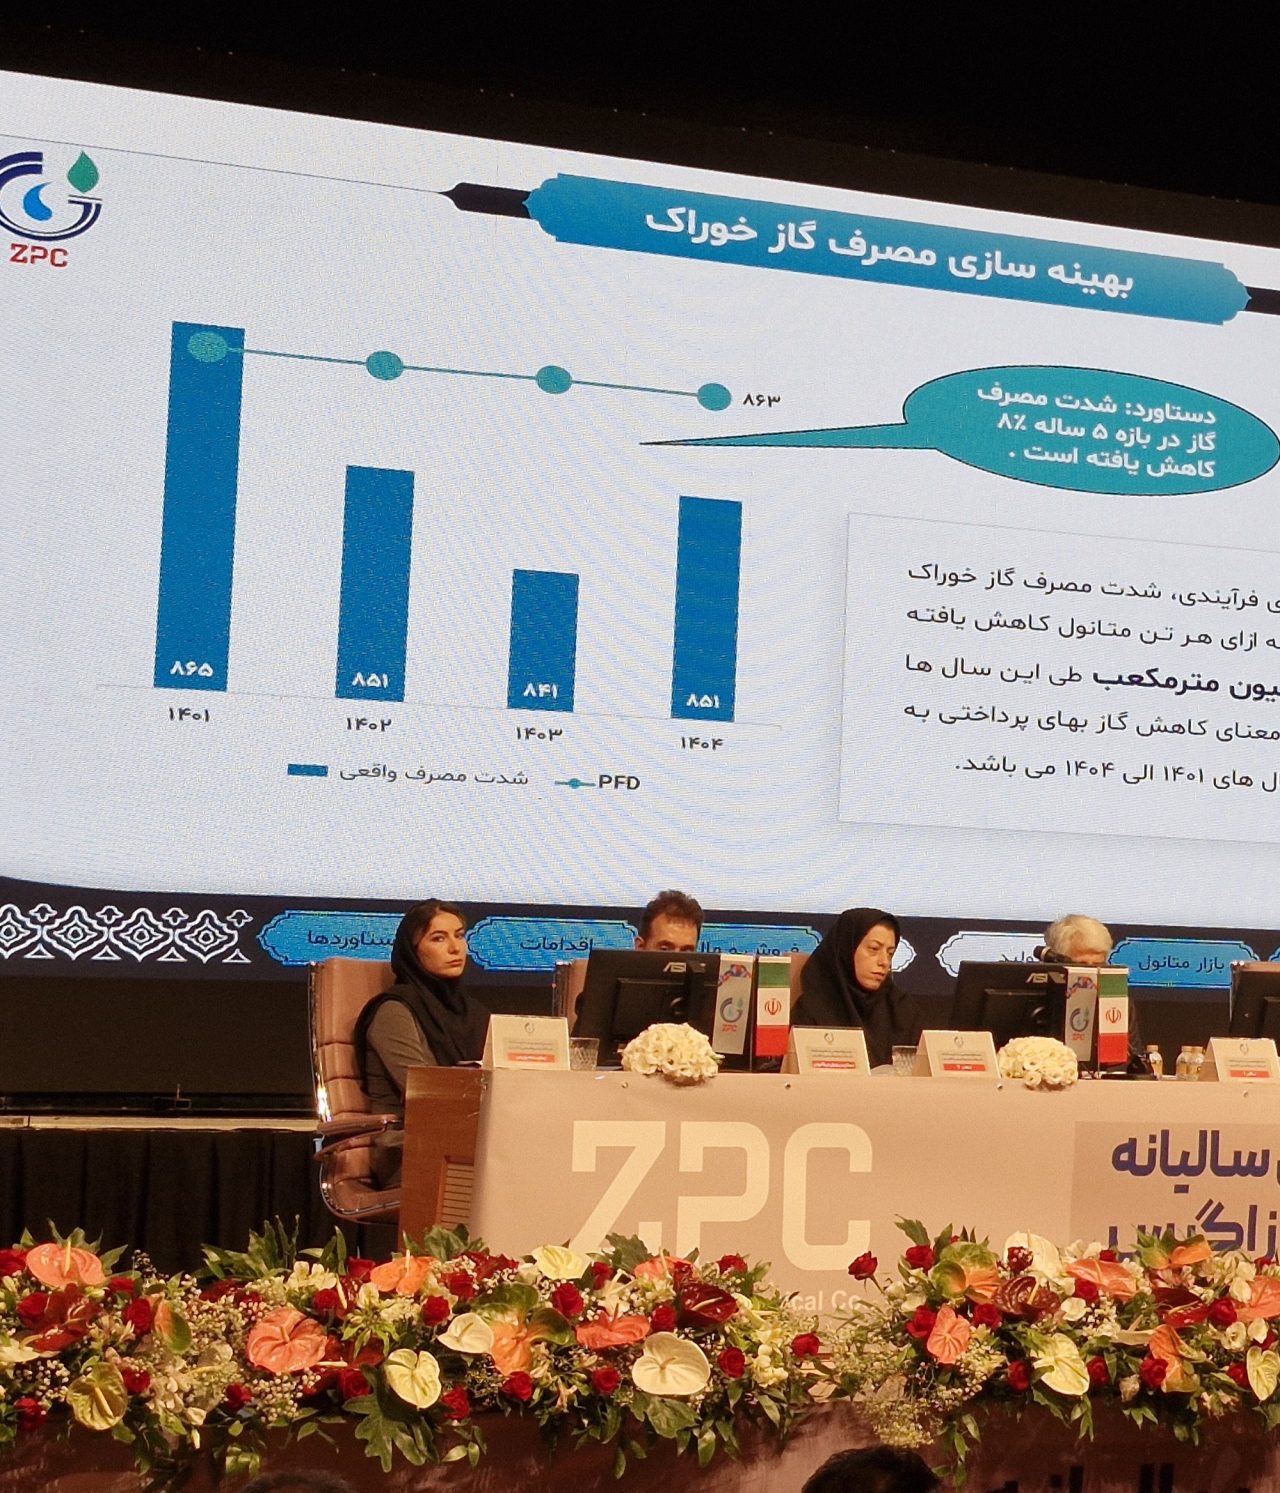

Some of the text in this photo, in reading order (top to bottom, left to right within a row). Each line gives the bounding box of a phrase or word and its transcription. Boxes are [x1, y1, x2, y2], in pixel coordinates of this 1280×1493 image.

[10, 243, 69, 268] ZPC
[645, 206, 1134, 299] بهینه سازی مصرف گاز خوراک
[742, 393, 782, 408] ۸۶۳
[977, 381, 1048, 407] مصرف
[1054, 394, 1118, 414] شدت
[1034, 417, 1086, 437] ساله
[1091, 423, 1109, 440] ۵
[1115, 426, 1152, 449] بازه
[1156, 433, 1181, 451] در
[1186, 431, 1217, 454] گاز
[1023, 446, 1079, 464] است
[1085, 450, 1140, 476] یافته
[1146, 455, 1216, 478] کاهش
[907, 563, 977, 588] خوراک
[984, 567, 1016, 591] گاز
[1022, 571, 1092, 596] مصرف
[1100, 582, 1162, 599] شدت
[906, 605, 967, 631] یافته
[974, 611, 1051, 633] کاهش
[1057, 617, 1132, 640] متانول
[1139, 626, 1174, 645] تن
[1179, 633, 1213, 648] هر
[1220, 630, 1258, 653] ازای
[169, 660, 214, 678] ۸۶۵
[905, 653, 933, 674] ها
[941, 657, 992, 679] سال
[999, 663, 1040, 685] این
[351, 671, 389, 688] ۸۵۱
[1048, 665, 1083, 687] طی
[1092, 667, 1220, 697] مترمکعب
[523, 682, 558, 699] ۸۴۱
[686, 692, 720, 709] ۸۵۱
[168, 706, 210, 723] ۱۴۰۱
[903, 704, 931, 723] به
[938, 705, 1030, 732] پرداختی
[1037, 710, 1089, 733] بهای
[1095, 711, 1129, 735] گاز
[346, 717, 392, 733] ۱۴۰۲
[516, 726, 564, 742] ۱۴۰۳
[1135, 716, 1208, 738] کاهش
[1215, 721, 1280, 743] معنای
[681, 736, 724, 751] ۱۴۰۴
[339, 763, 529, 785] شدت مصرف واقعی
[1024, 764, 1056, 780] می
[1066, 760, 1115, 778] ۱۴۰۴
[1122, 763, 1154, 785] الی
[1163, 765, 1204, 784] ۱۴۰۱
[1212, 769, 1254, 790] های
[598, 773, 641, 791] PFD
[307, 930, 394, 949] ستاوردها
[520, 936, 593, 950] اقدامات
[1138, 954, 1226, 973] بازار متانول
[1111, 1129, 1270, 1194] سالیانه
[571, 1120, 873, 1271] ZPC
[1108, 1198, 1278, 1261] زاگس
